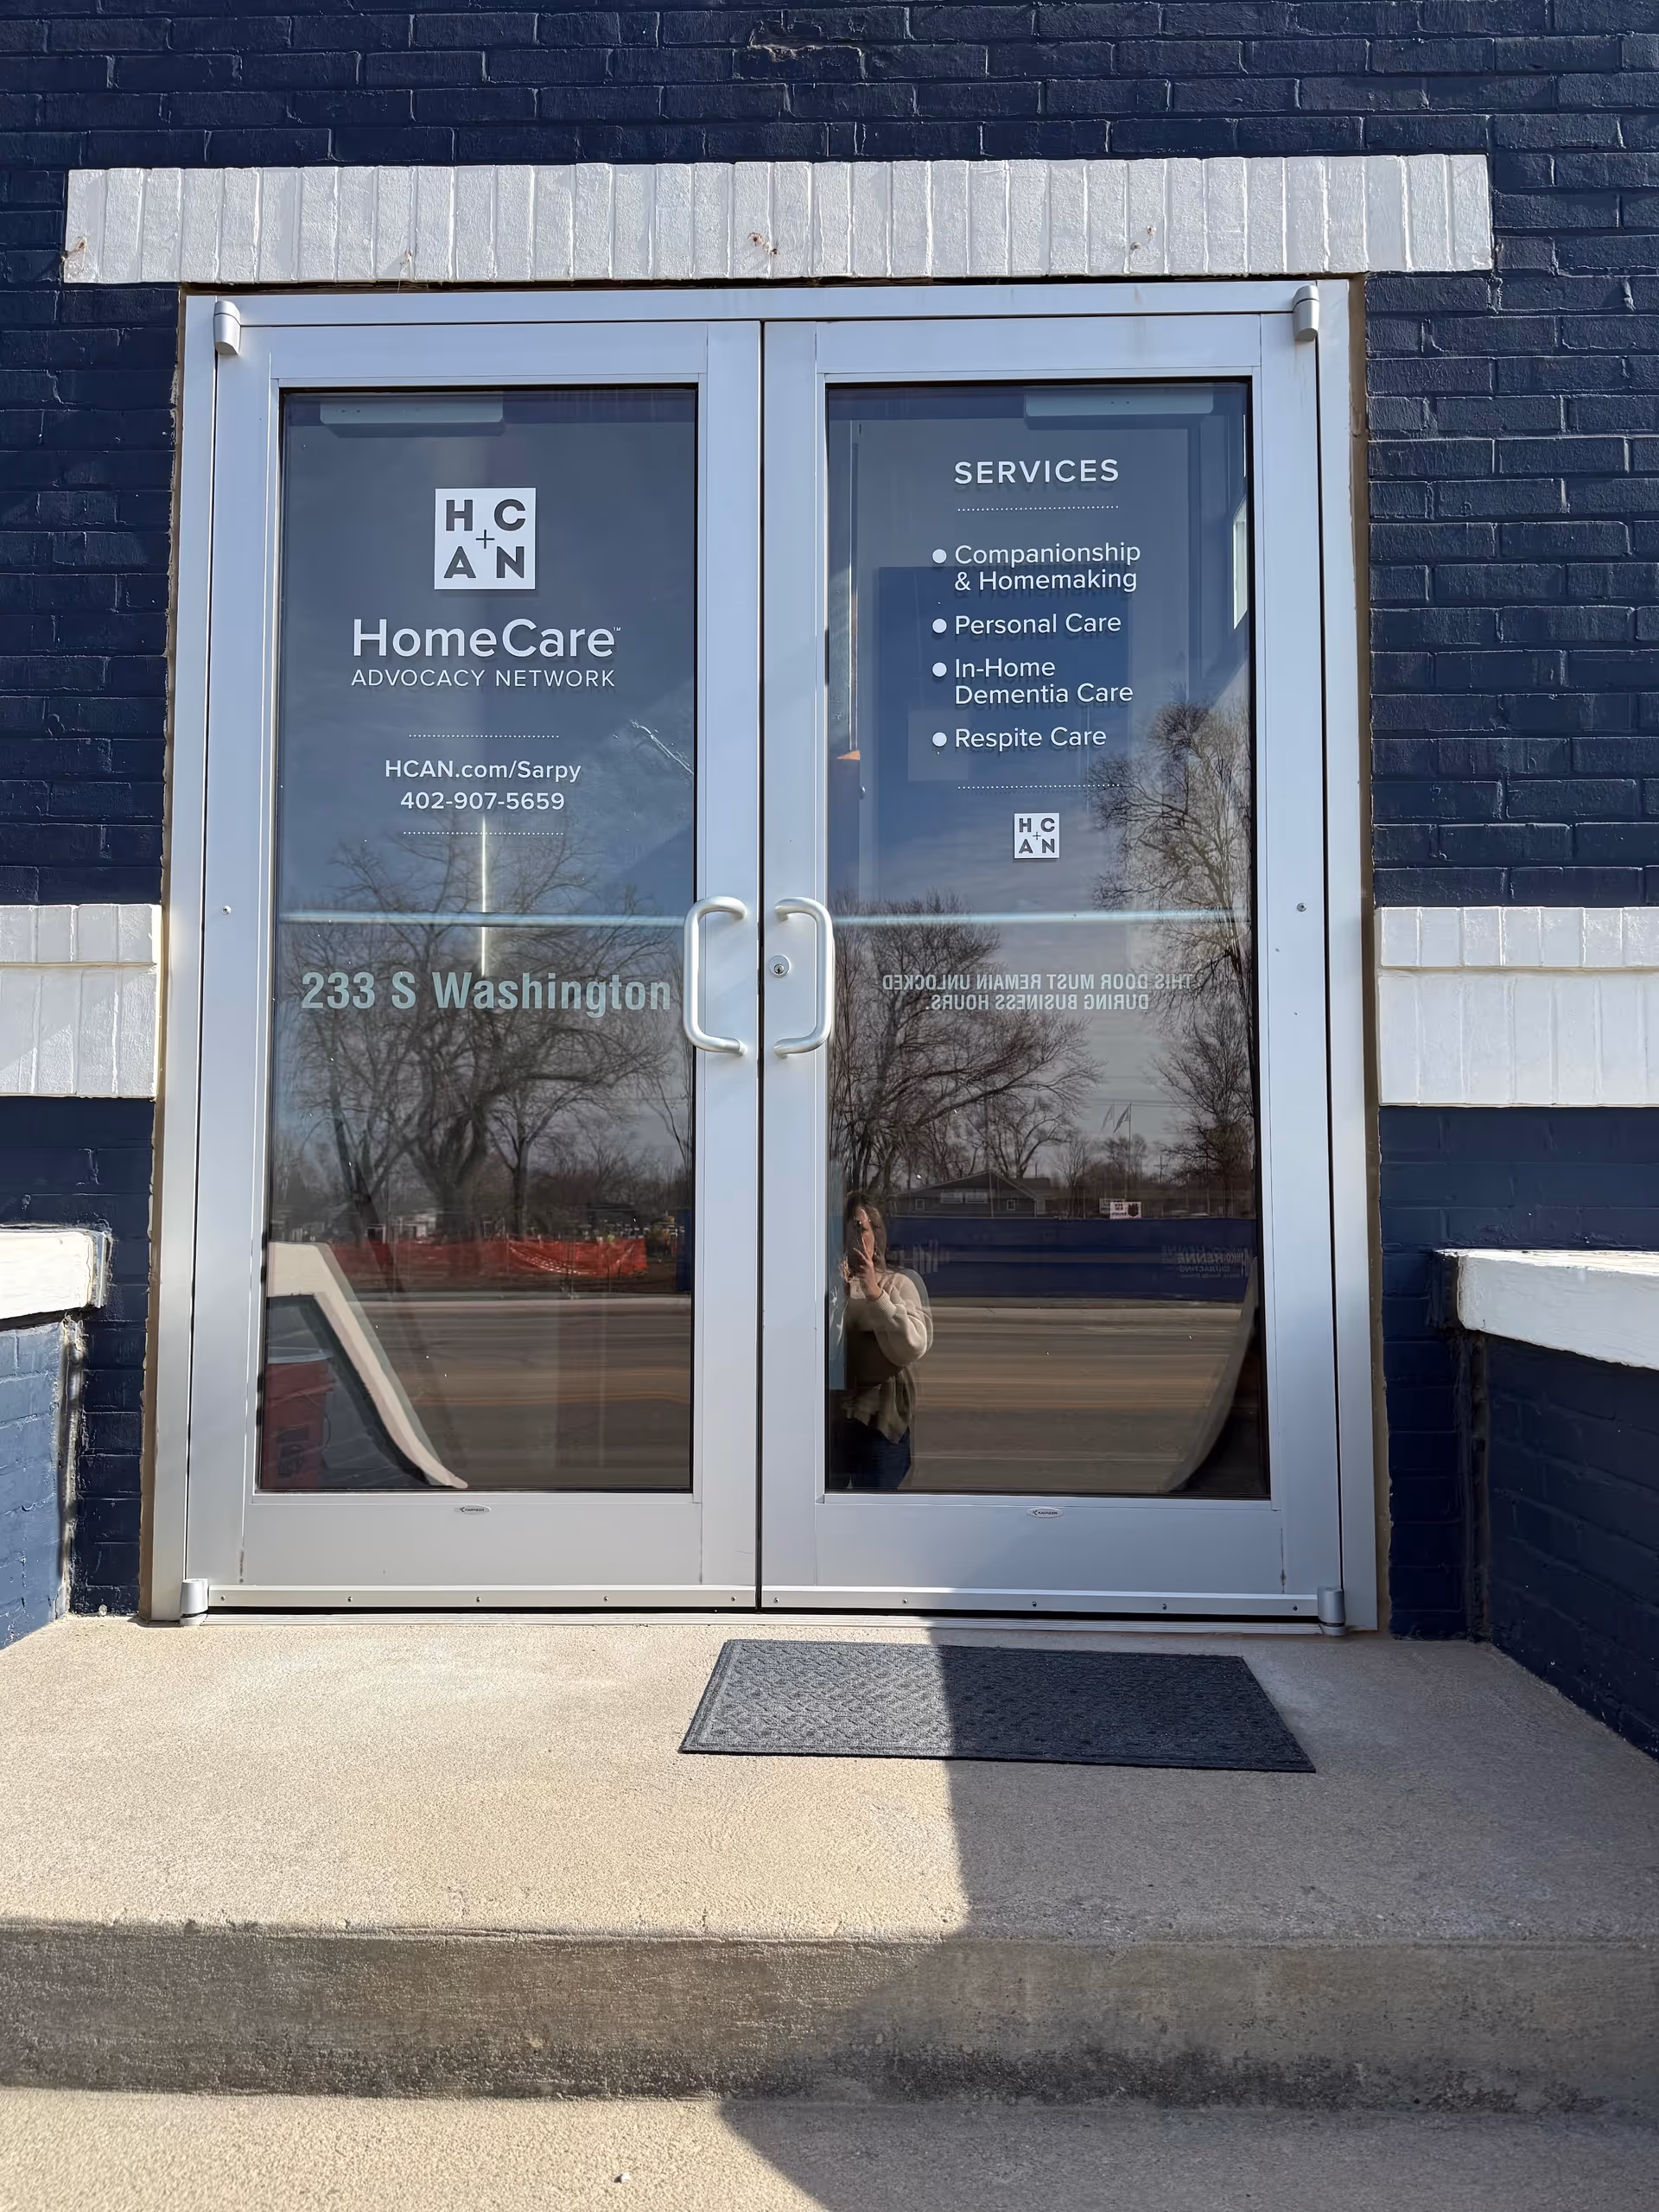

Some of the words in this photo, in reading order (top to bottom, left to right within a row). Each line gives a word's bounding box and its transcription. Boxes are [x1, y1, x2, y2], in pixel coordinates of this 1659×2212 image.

[954, 459, 1119, 485] SERVICES
[955, 542, 1141, 569] Companionship
[954, 571, 971, 591] &
[979, 566, 1137, 593] Homemaking
[956, 613, 1057, 635] Personal
[1065, 613, 1122, 632] Care
[351, 669, 486, 687] ADVOCACY
[496, 669, 615, 687] NETWORK
[956, 658, 1056, 678] In-Home
[956, 683, 1069, 705] Dementia
[1077, 682, 1134, 702] Care
[956, 727, 1043, 751] Respite
[1050, 726, 1107, 746] Care
[385, 760, 582, 783] HCAN.com/Sarpy
[400, 791, 565, 810] 402-907-5659
[301, 970, 376, 1010] 233
[391, 970, 416, 1010] S
[432, 970, 671, 1019] Washington
